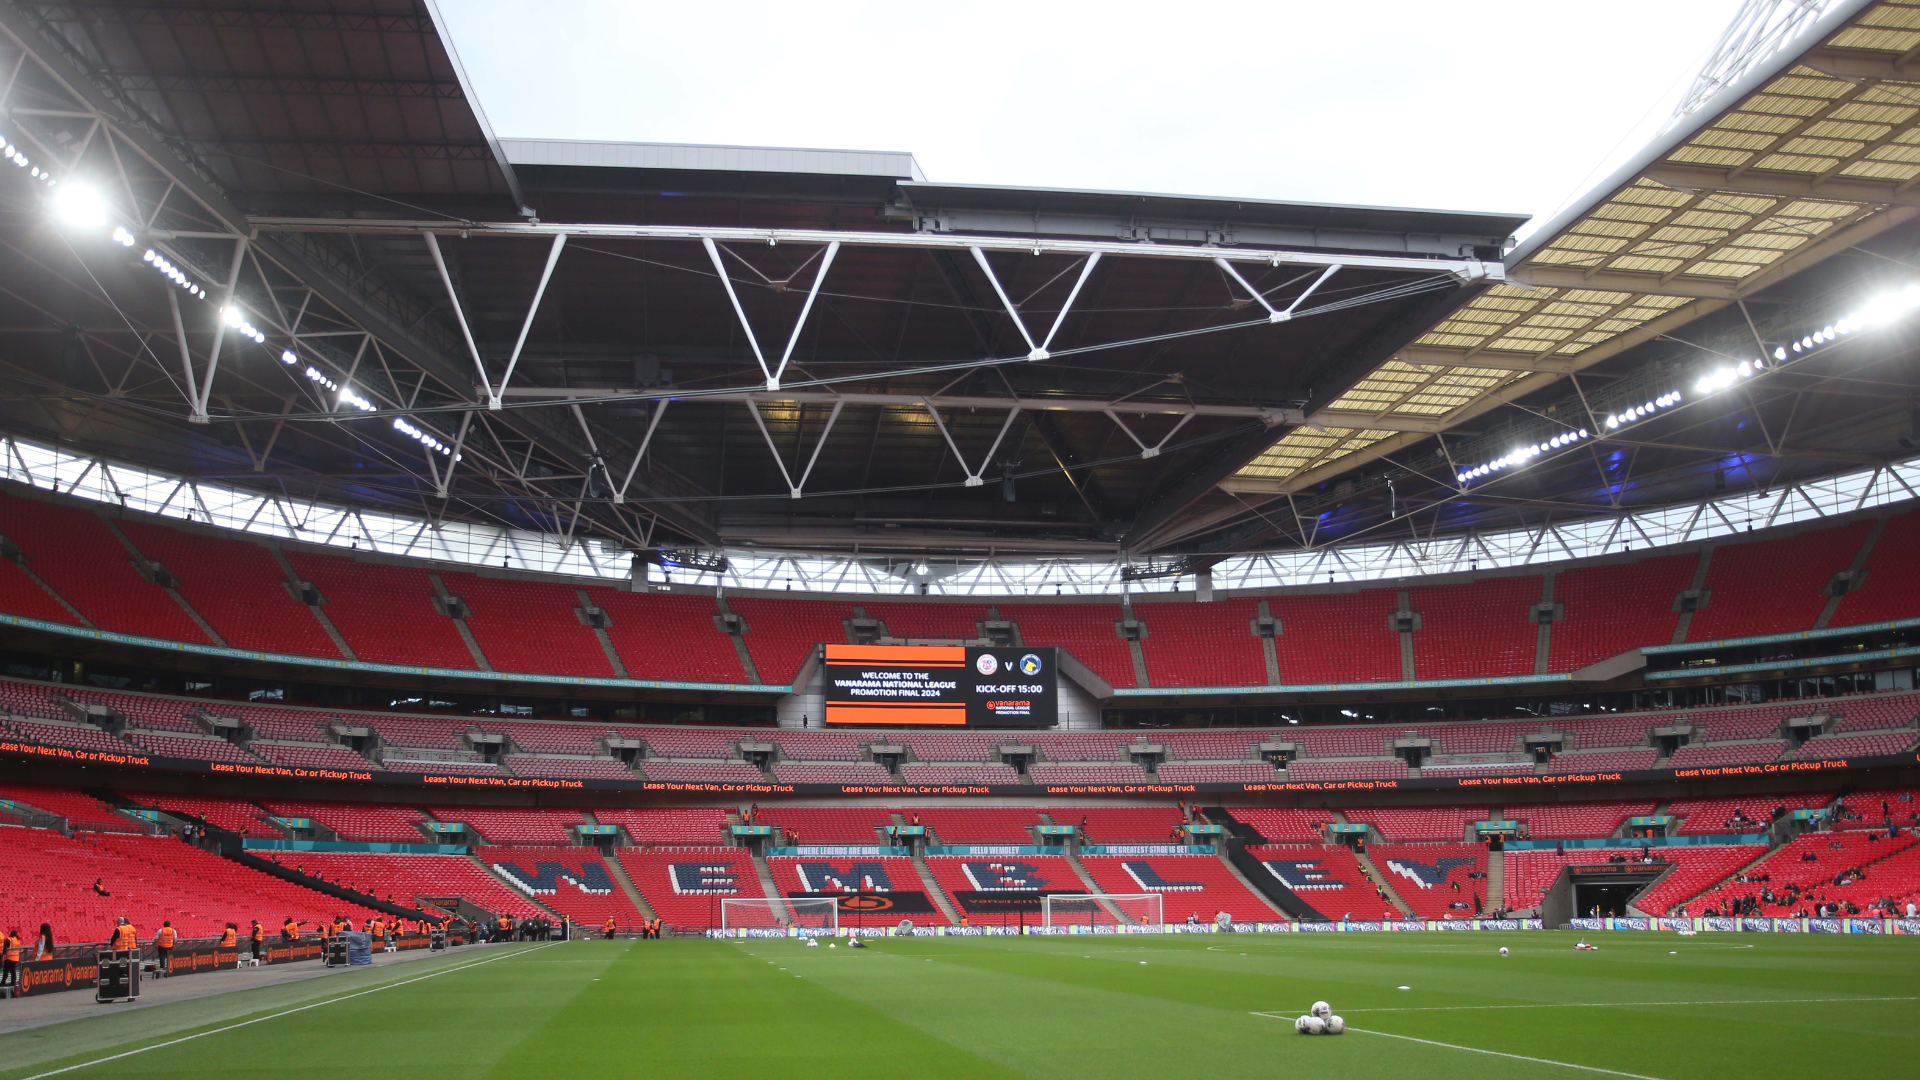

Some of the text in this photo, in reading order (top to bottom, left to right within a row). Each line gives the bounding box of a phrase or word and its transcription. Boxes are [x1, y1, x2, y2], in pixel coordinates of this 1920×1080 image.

[19, 619, 45, 629] WEMBLEY
[46, 624, 80, 634] CONNECTED
[1837, 625, 1872, 634] CONNECTED
[101, 634, 128, 642] WEMBLEY
[128, 637, 164, 647] CONNECTED
[1751, 634, 1786, 643] CONNECTED
[184, 645, 210, 653] WEMBLEY
[211, 648, 245, 657] CONNECTED
[292, 657, 326, 665] CONNECTED
[1754, 661, 1788, 670] CONNECTED
[374, 665, 408, 673] CONNECTED
[902, 672, 913, 680] TO
[882, 680, 923, 688] NATIONAL
[924, 681, 956, 689] LEAGUE
[976, 685, 1042, 693] KICK-OFF 15:00
[898, 689, 920, 697] FINAL
[921, 689, 940, 697] 2024
[0, 742, 18, 751] ease
[19, 744, 36, 753] Your
[37, 746, 56, 756] Next
[57, 748, 74, 759] Van,
[75, 750, 88, 759] Car
[99, 752, 126, 764] Pickup
[127, 755, 149, 765] Truck
[211, 762, 234, 772] Lease
[235, 765, 254, 773] Your
[255, 766, 274, 774] Next
[275, 768, 294, 777] Van,
[295, 768, 308, 776] Car
[319, 770, 347, 779] Pickup
[349, 771, 372, 779] Truck
[1675, 769, 1700, 777] Lease
[1765, 764, 1779, 772] Car
[1792, 762, 1822, 770] Pickup
[424, 775, 447, 783] Lease
[448, 776, 467, 784] Your
[488, 778, 506, 786] Van,
[532, 779, 559, 788] Pickup
[704, 784, 721, 792] Van,
[797, 847, 880, 855] WHERE LEGENDS ARE MADE
[970, 846, 1019, 854] HELLO WEMBLEY
[30, 968, 64, 985] vanarama
[73, 966, 98, 980] vanaram
